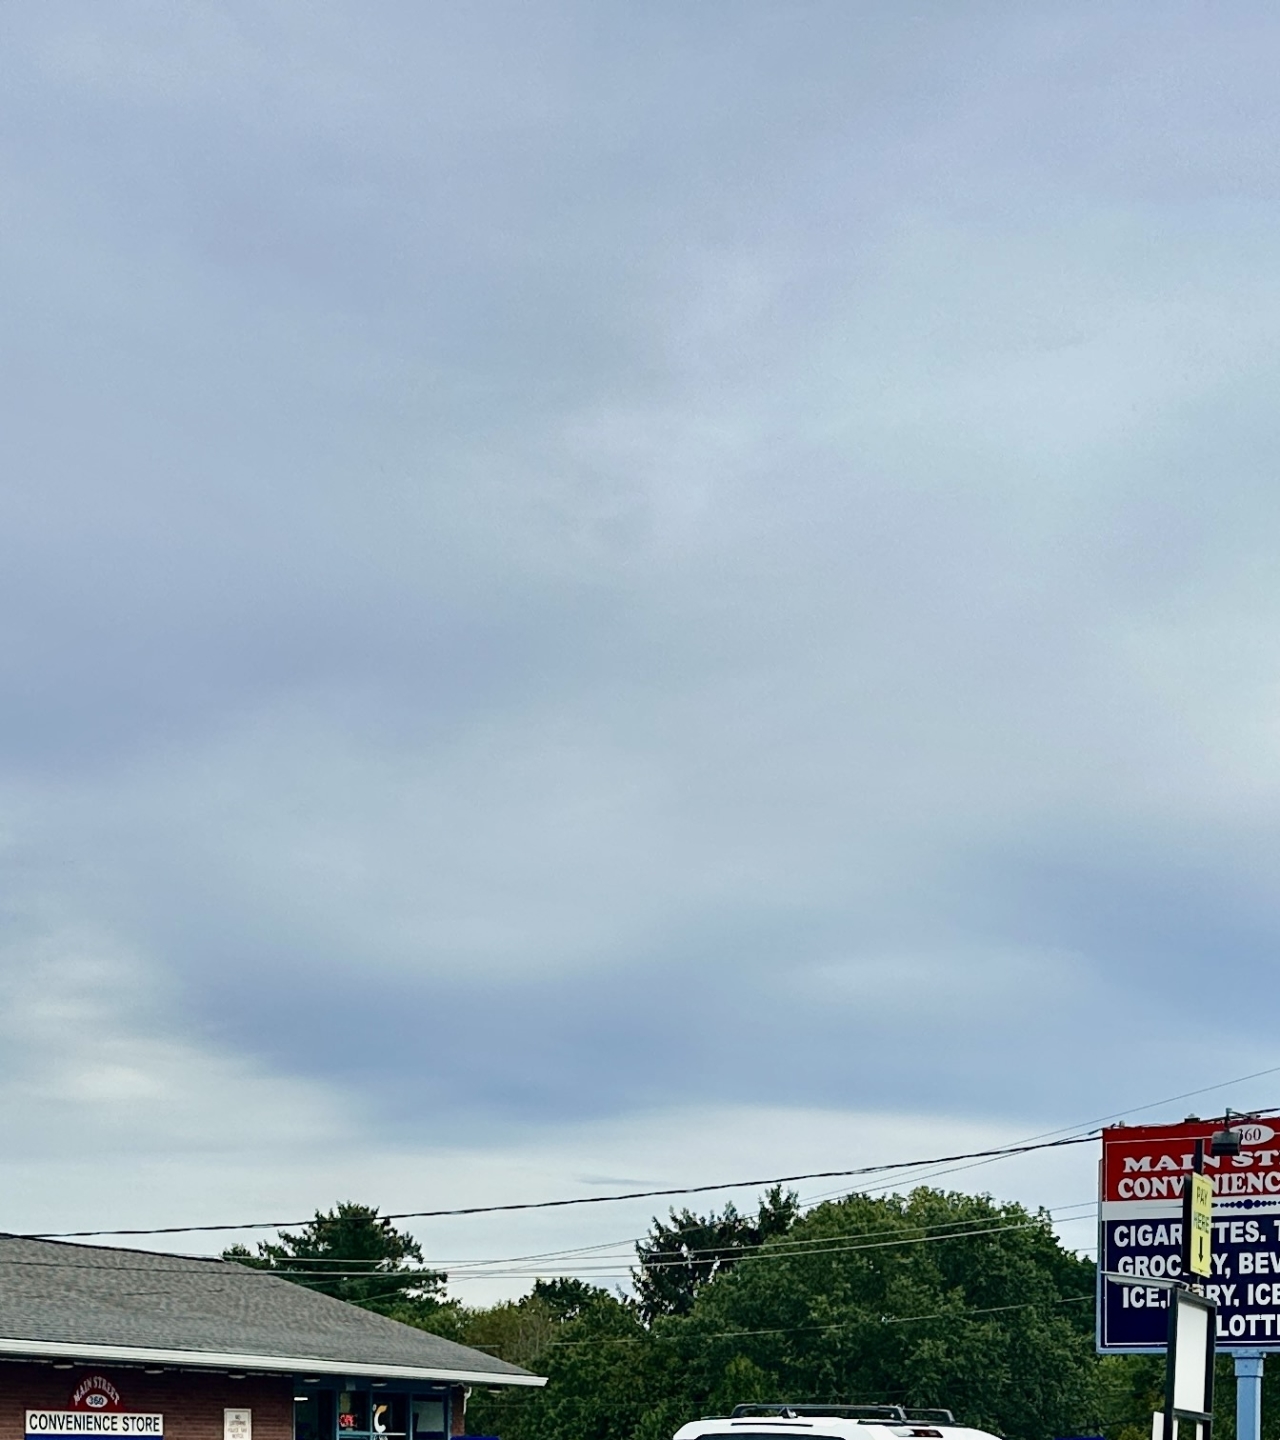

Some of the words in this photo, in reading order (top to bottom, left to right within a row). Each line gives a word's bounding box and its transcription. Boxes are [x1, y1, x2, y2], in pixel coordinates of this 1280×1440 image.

[1113, 1220, 1267, 1248] CIGARTES.
[1117, 1251, 1232, 1280] GROCY,
[73, 1376, 93, 1407] MAIN
[93, 1375, 121, 1406] STREET
[28, 1413, 119, 1432] CONVENIENCE
[121, 1416, 161, 1432] STORE
